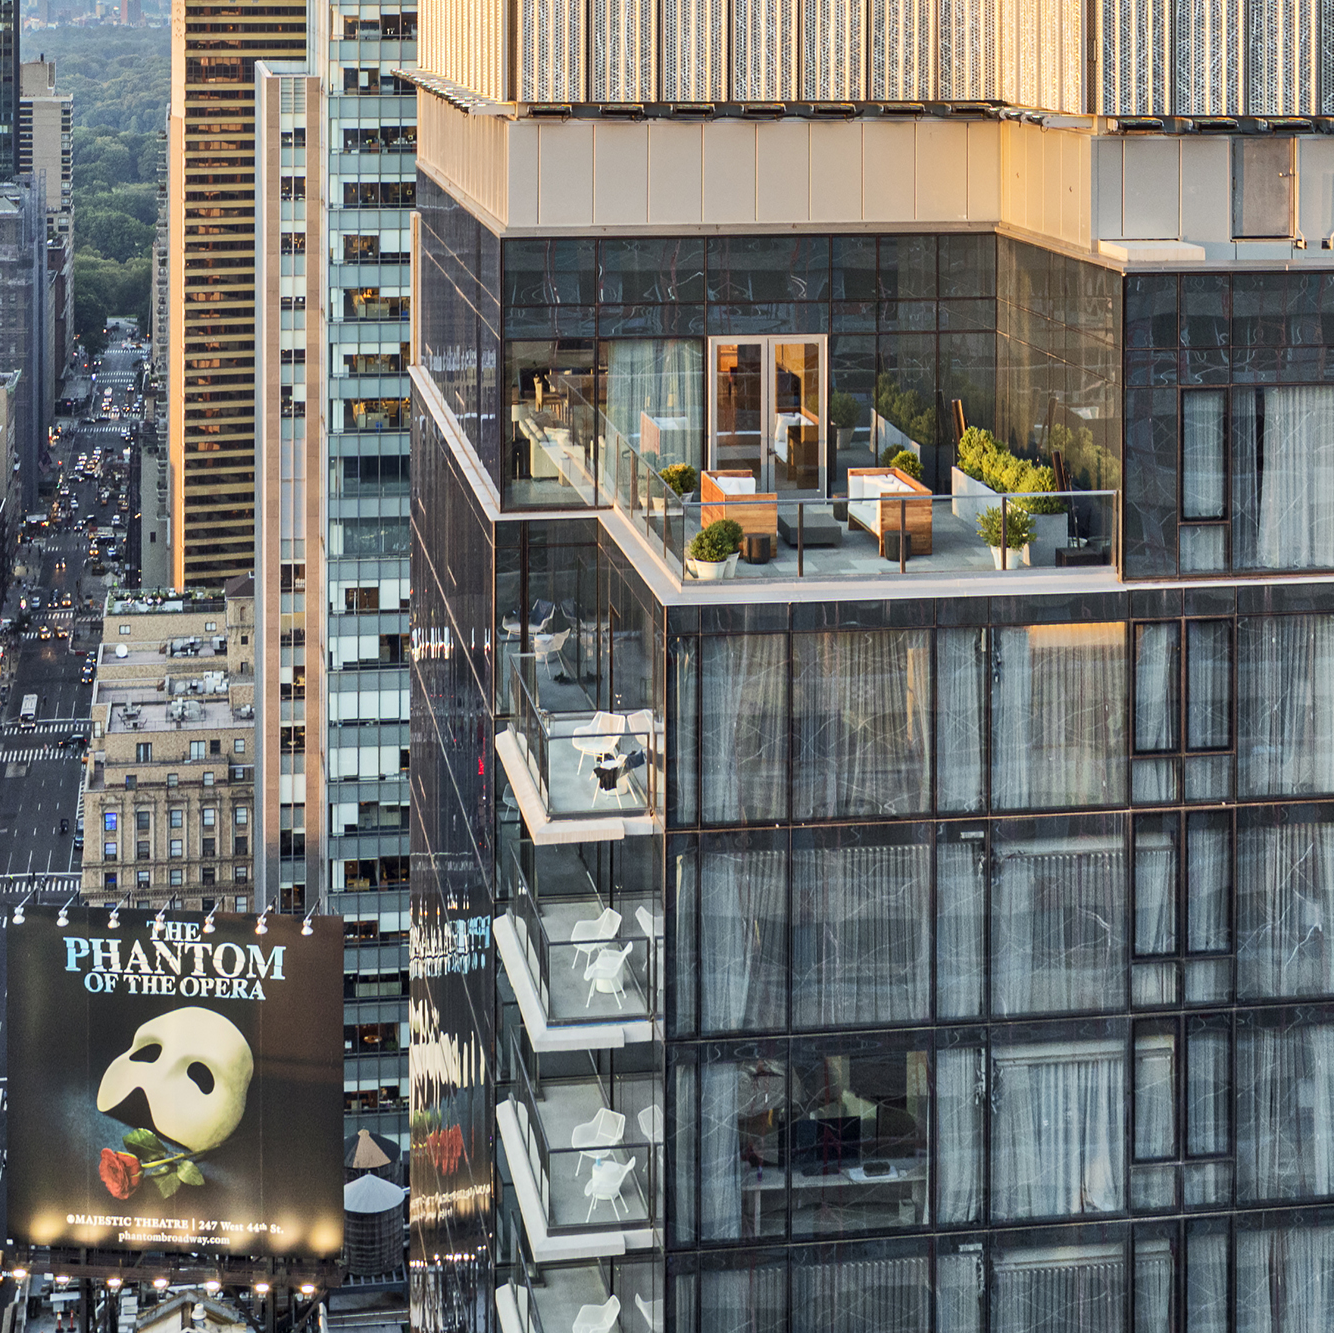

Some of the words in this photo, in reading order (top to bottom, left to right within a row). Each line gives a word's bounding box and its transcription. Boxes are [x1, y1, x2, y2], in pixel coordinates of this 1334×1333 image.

[146, 921, 202, 941] THE
[63, 937, 286, 980] PHANTOM
[84, 972, 119, 993] OF
[123, 974, 176, 995] THE
[179, 976, 266, 1000] OPERA
[75, 1214, 132, 1227] MAJESTIC
[134, 1217, 189, 1229] THEATRE
[198, 1220, 218, 1231] 247
[220, 1221, 244, 1232] West
[247, 1222, 268, 1233] 44th
[270, 1223, 284, 1234] St.
[118, 1230, 230, 1246] phantombroadway.com
